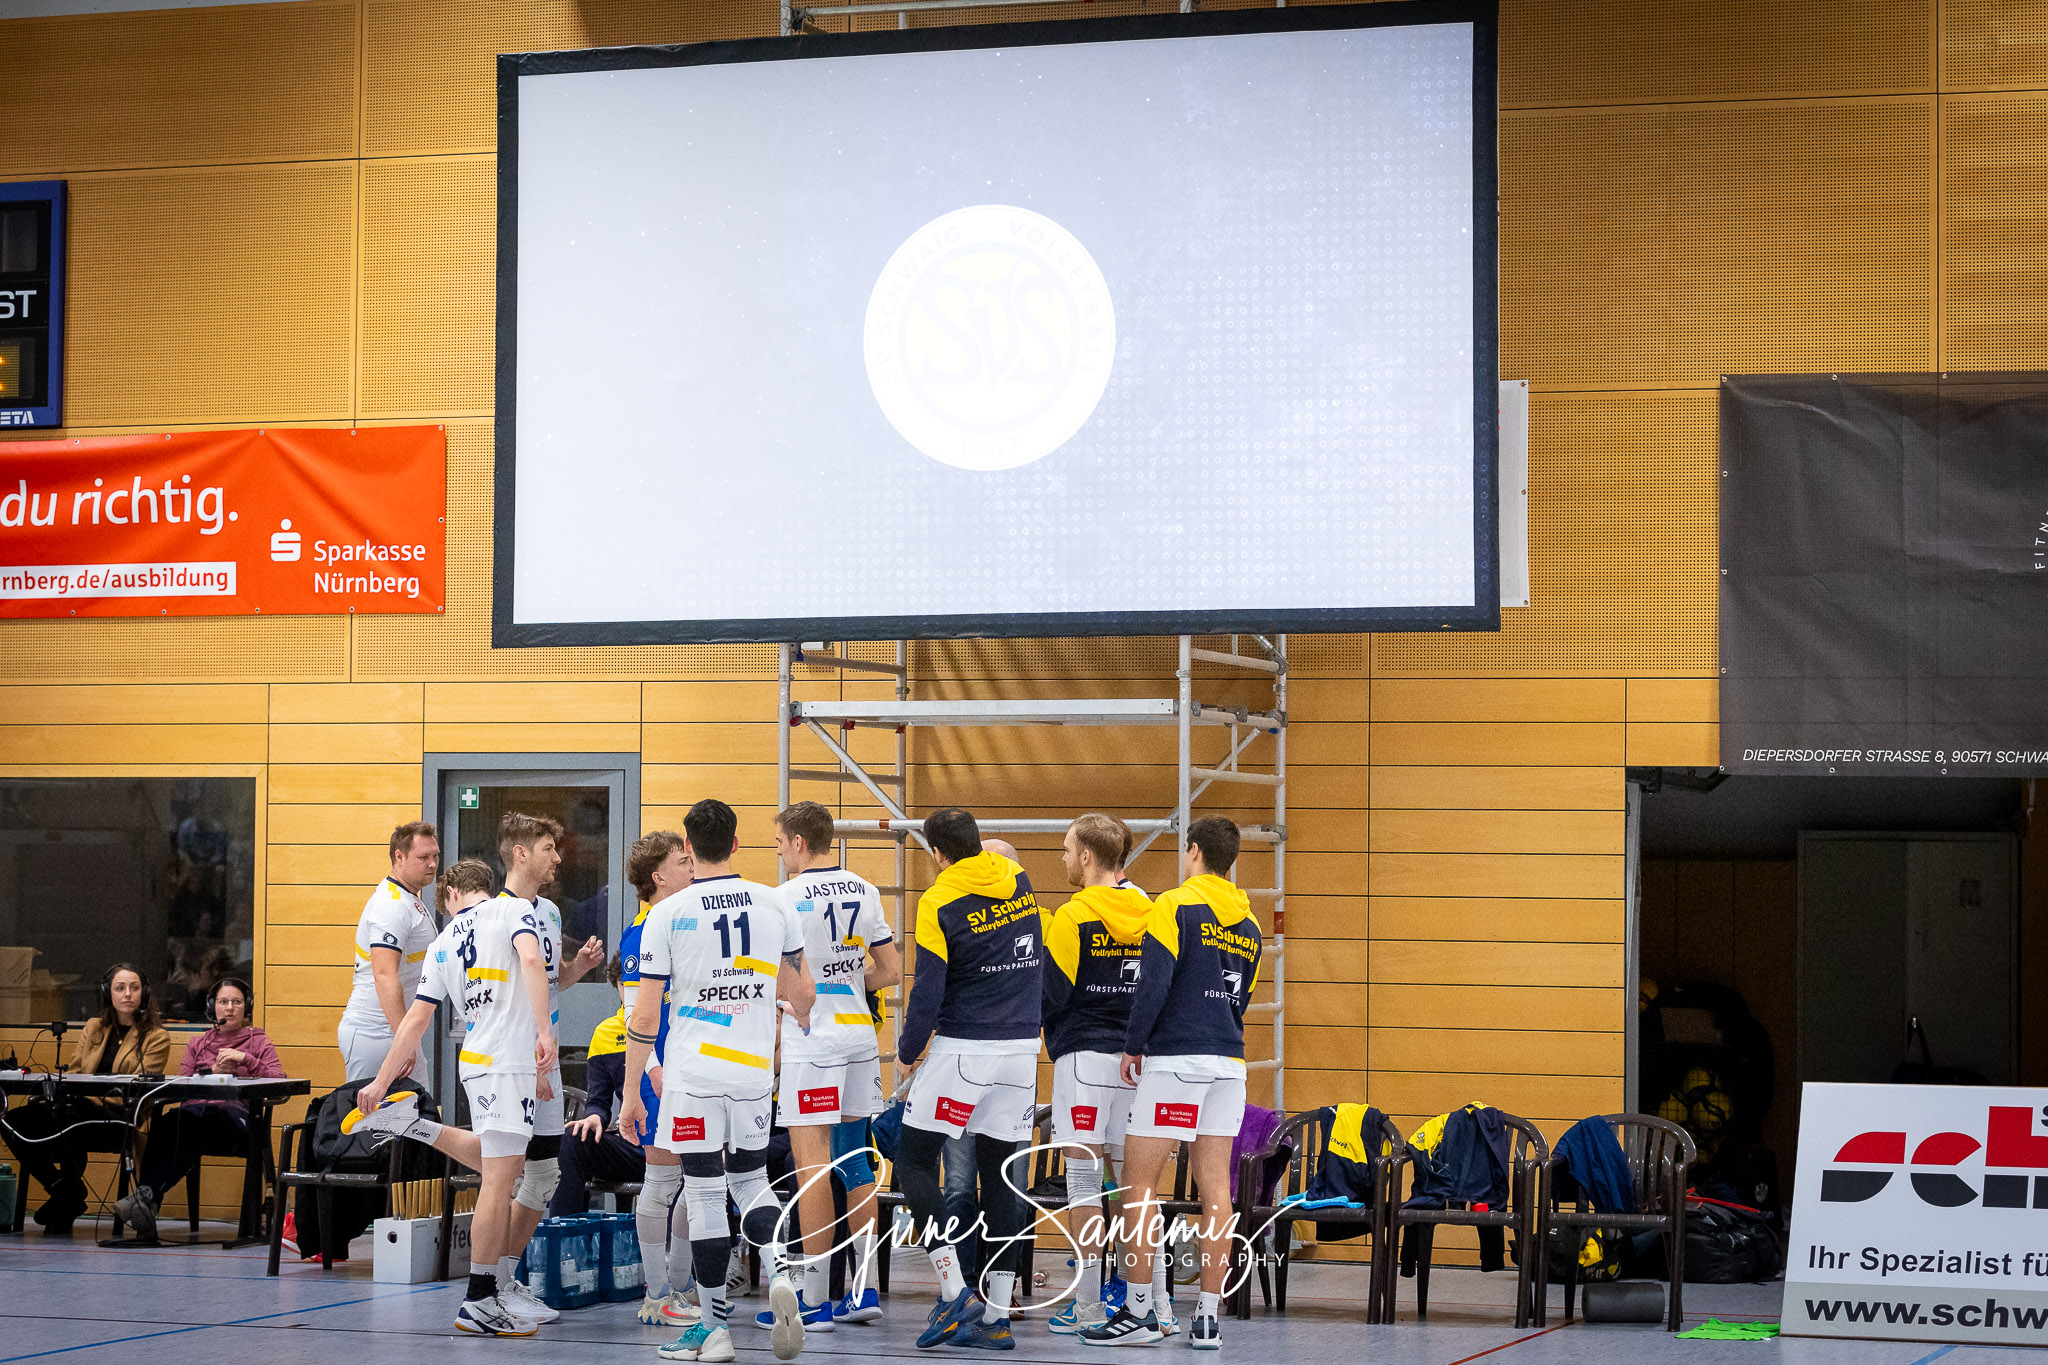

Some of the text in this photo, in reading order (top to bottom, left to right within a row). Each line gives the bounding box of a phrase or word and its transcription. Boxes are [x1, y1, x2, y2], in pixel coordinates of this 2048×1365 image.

[877, 225, 961, 336] SCHWAIG
[1008, 218, 1103, 376] VOLLEYBALL
[959, 436, 1019, 458] 1967
[0, 474, 239, 535] du richtig.
[2034, 511, 2048, 570] FITN
[313, 538, 427, 567] Sparkasse
[313, 570, 420, 599] Nürnberg
[1742, 748, 1862, 763] DIEPERSDORFER
[1865, 749, 1932, 764] STRASSE
[1934, 749, 1948, 765] 8,
[1951, 750, 1992, 764] 90571
[701, 891, 753, 911] DZIERWA
[805, 881, 866, 900] JASTROW
[966, 891, 1037, 927] SV Schwaig
[823, 901, 861, 943] 17
[970, 916, 1010, 935] Volleyball
[1201, 922, 1217, 937] SV
[713, 911, 751, 959] 11
[1091, 933, 1110, 947] SV
[543, 936, 553, 964] 9
[712, 965, 754, 979] SV Schwaig
[822, 959, 856, 978] SPCK
[697, 984, 750, 1003] SPECK
[695, 1002, 750, 1019] pumpen
[935, 1256, 952, 1270] CS
[1808, 1245, 1851, 1270] Ihr
[1859, 1247, 2013, 1277] Spezialist
[1804, 1298, 2048, 1330] www.schw
